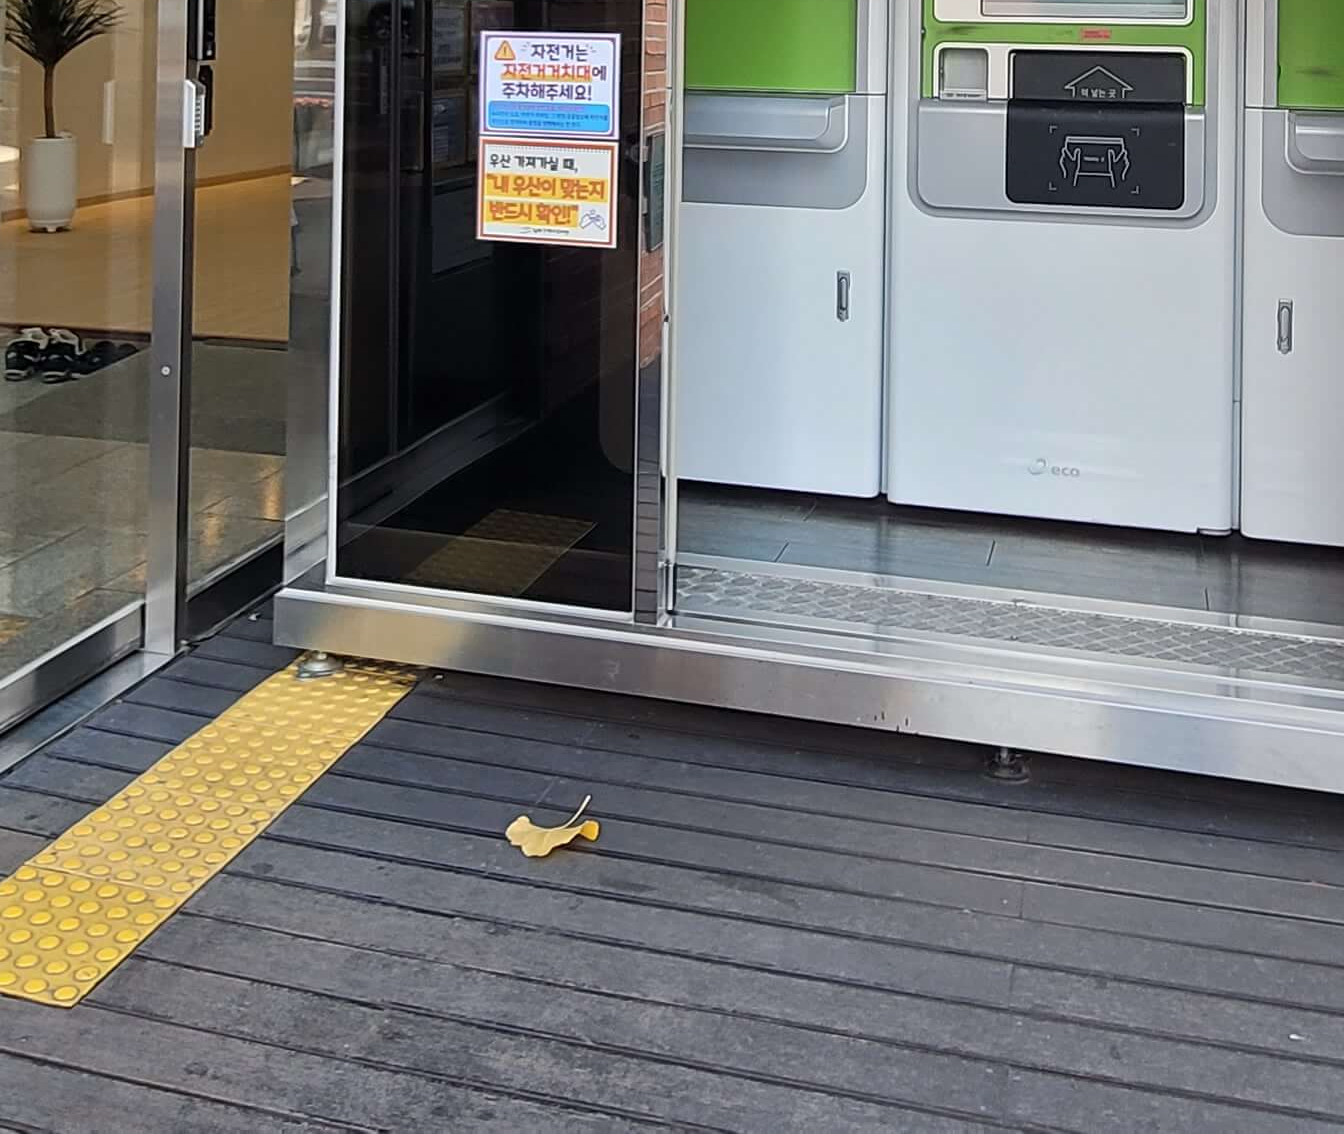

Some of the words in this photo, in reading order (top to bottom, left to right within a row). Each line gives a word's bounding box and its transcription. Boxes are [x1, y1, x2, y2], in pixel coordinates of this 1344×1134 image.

[531, 43, 589, 63] 자전거는
[502, 63, 608, 83] 자전거거치대에
[502, 81, 593, 102] 주차해주세요!
[1108, 89, 1117, 99] 곳
[490, 153, 512, 169] 우산
[514, 154, 560, 173] 가져가실
[562, 157, 579, 174] 때,
[512, 176, 557, 197] 우산이
[559, 178, 606, 201] 맞는지
[489, 200, 533, 221] 반드시
